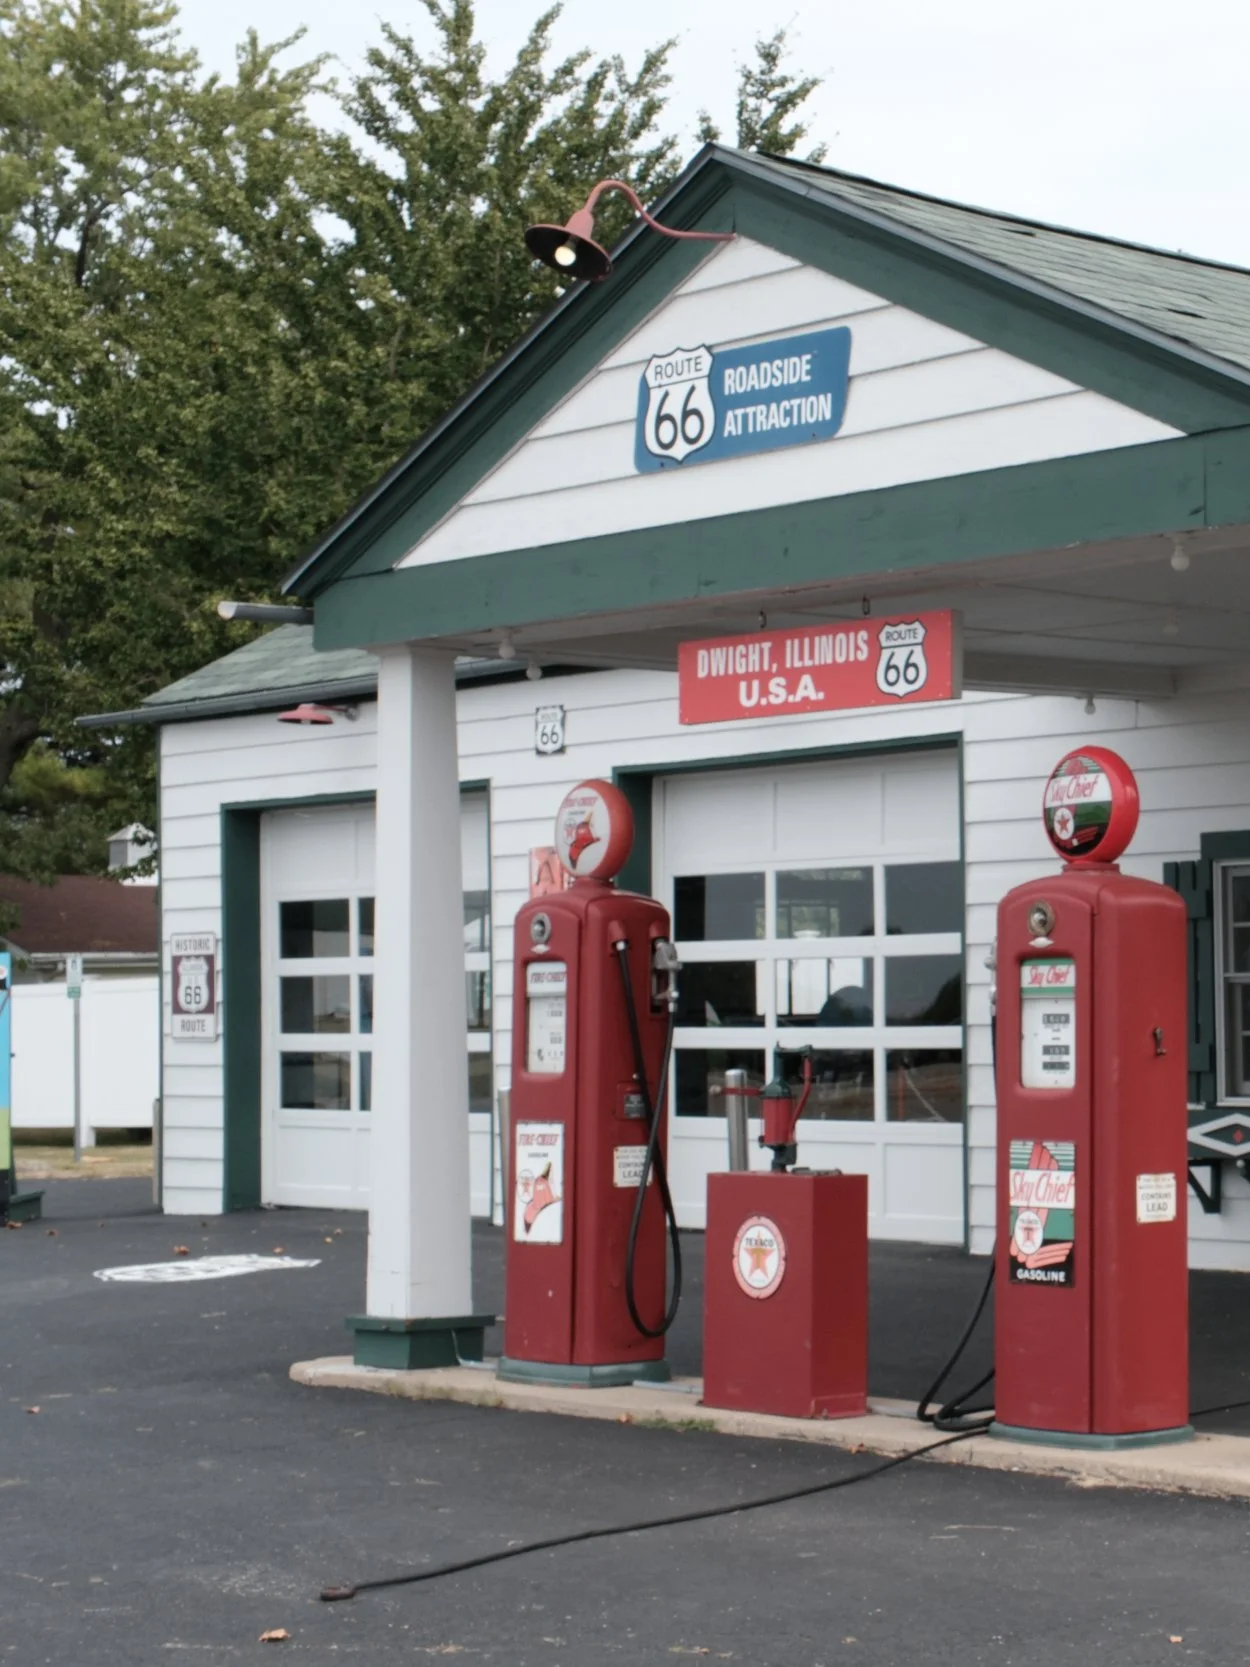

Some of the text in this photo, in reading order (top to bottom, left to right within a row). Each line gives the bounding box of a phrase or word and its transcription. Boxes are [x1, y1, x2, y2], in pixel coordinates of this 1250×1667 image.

[654, 356, 703, 380] ROUTE
[724, 355, 812, 395] ROADSIDE
[655, 384, 704, 450] 66
[723, 393, 832, 437] ATTRACTION
[885, 627, 918, 642] ROUTE
[697, 630, 869, 678] DWIGHT, ILLINOIS
[884, 650, 919, 687] 66
[739, 674, 824, 707] U.S.A.
[540, 724, 559, 745] 66
[175, 938, 210, 952] HISTORIC
[184, 986, 202, 1005] 66
[180, 1019, 206, 1033] ROUTE
[1012, 1171, 1076, 1209] Sky Chief
[1146, 1202, 1168, 1212] LEAD
[1016, 1268, 1066, 1283] GASOLINE
